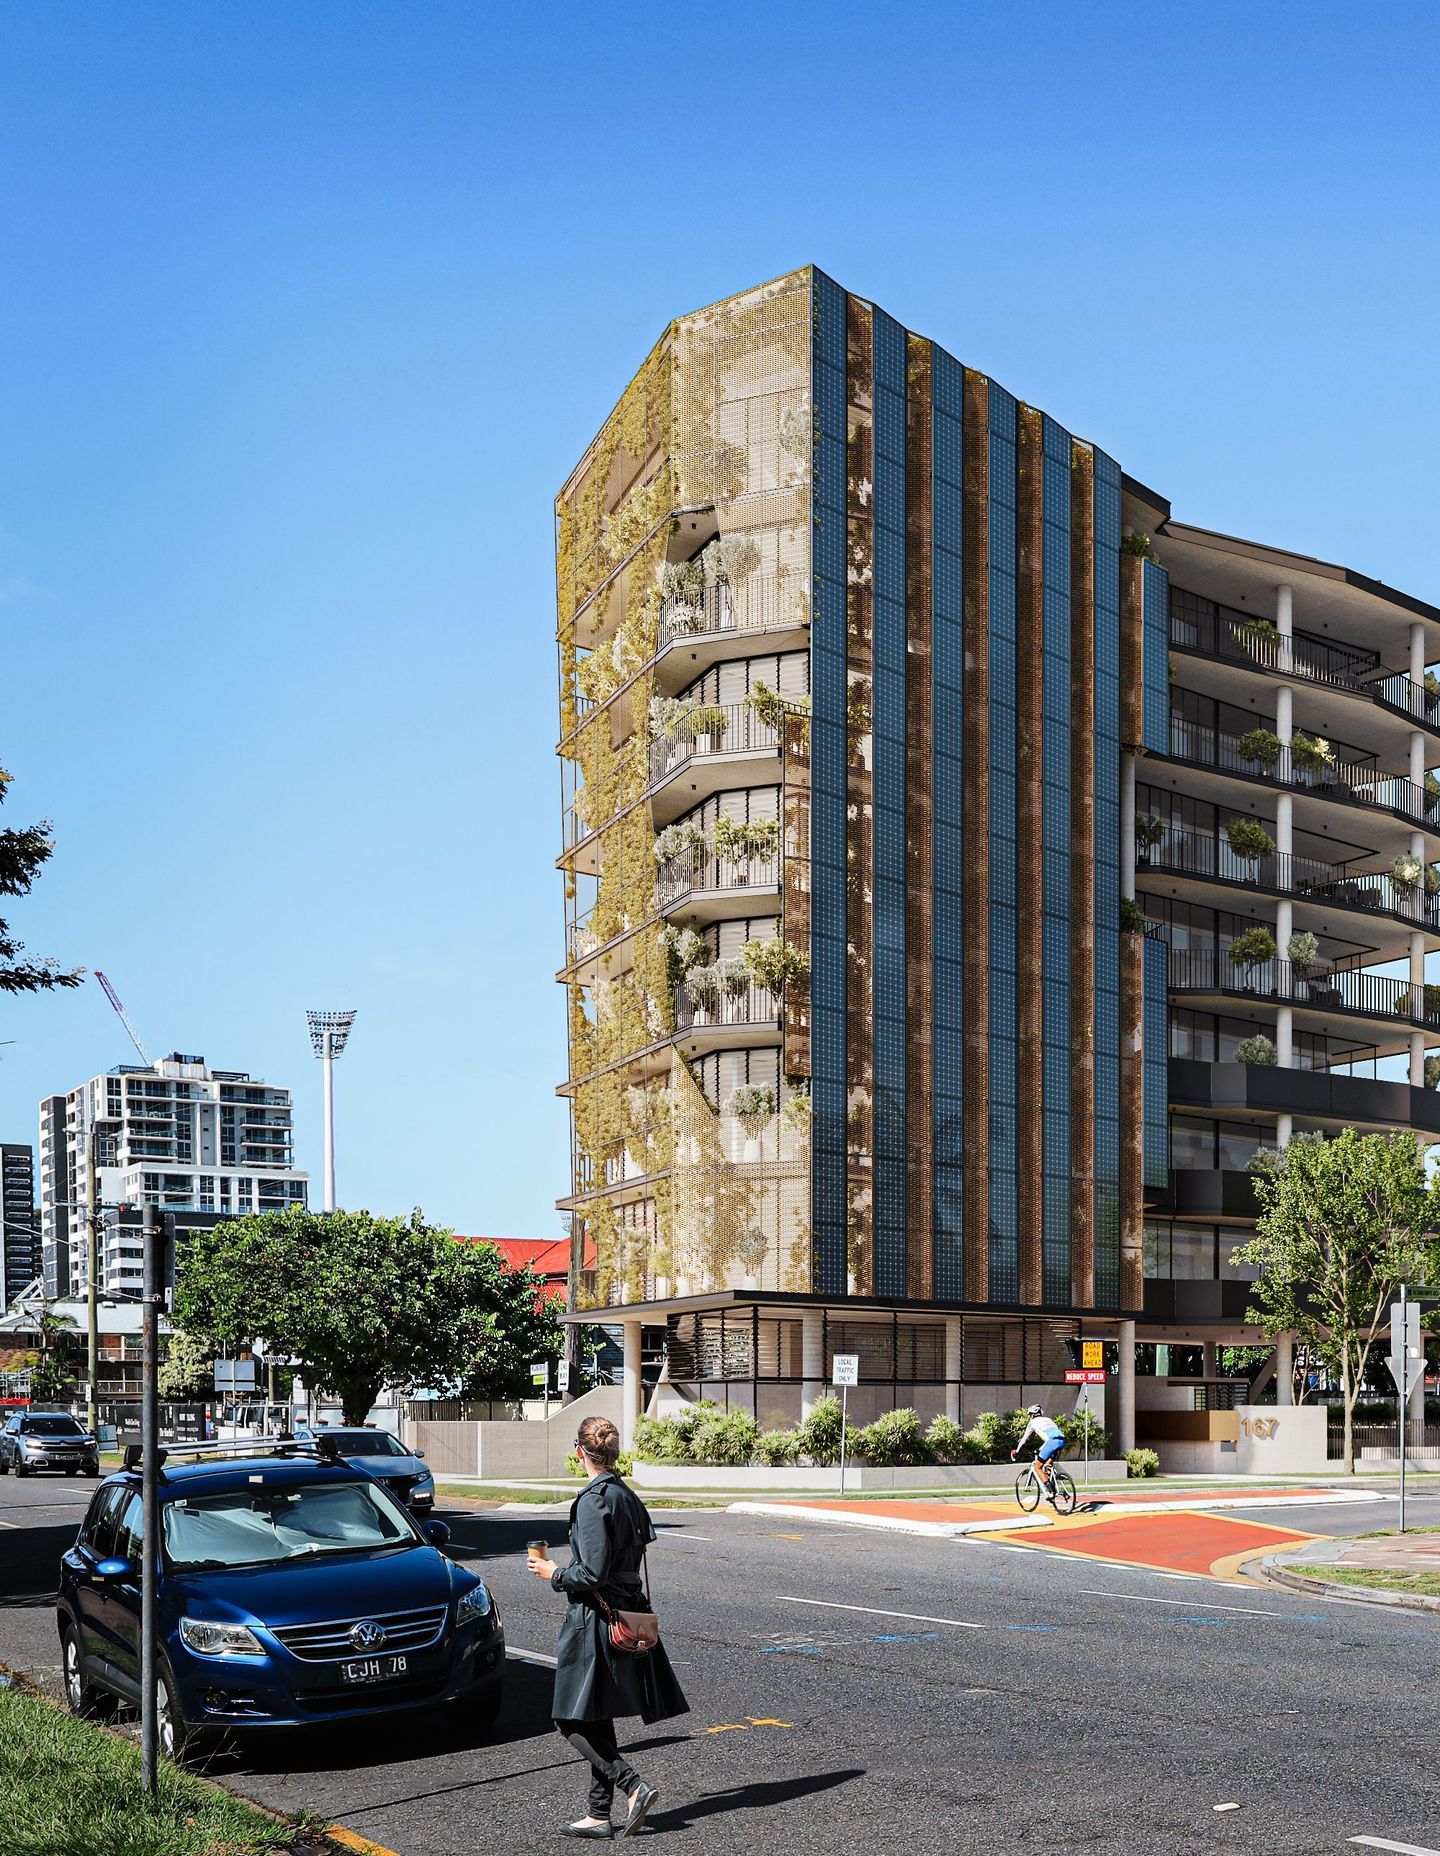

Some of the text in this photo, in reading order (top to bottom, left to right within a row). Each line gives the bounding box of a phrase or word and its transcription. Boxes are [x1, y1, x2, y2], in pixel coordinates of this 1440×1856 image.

[1241, 1417, 1278, 1438] 167
[347, 1660, 380, 1679] CJH
[388, 1656, 407, 1672] 78
